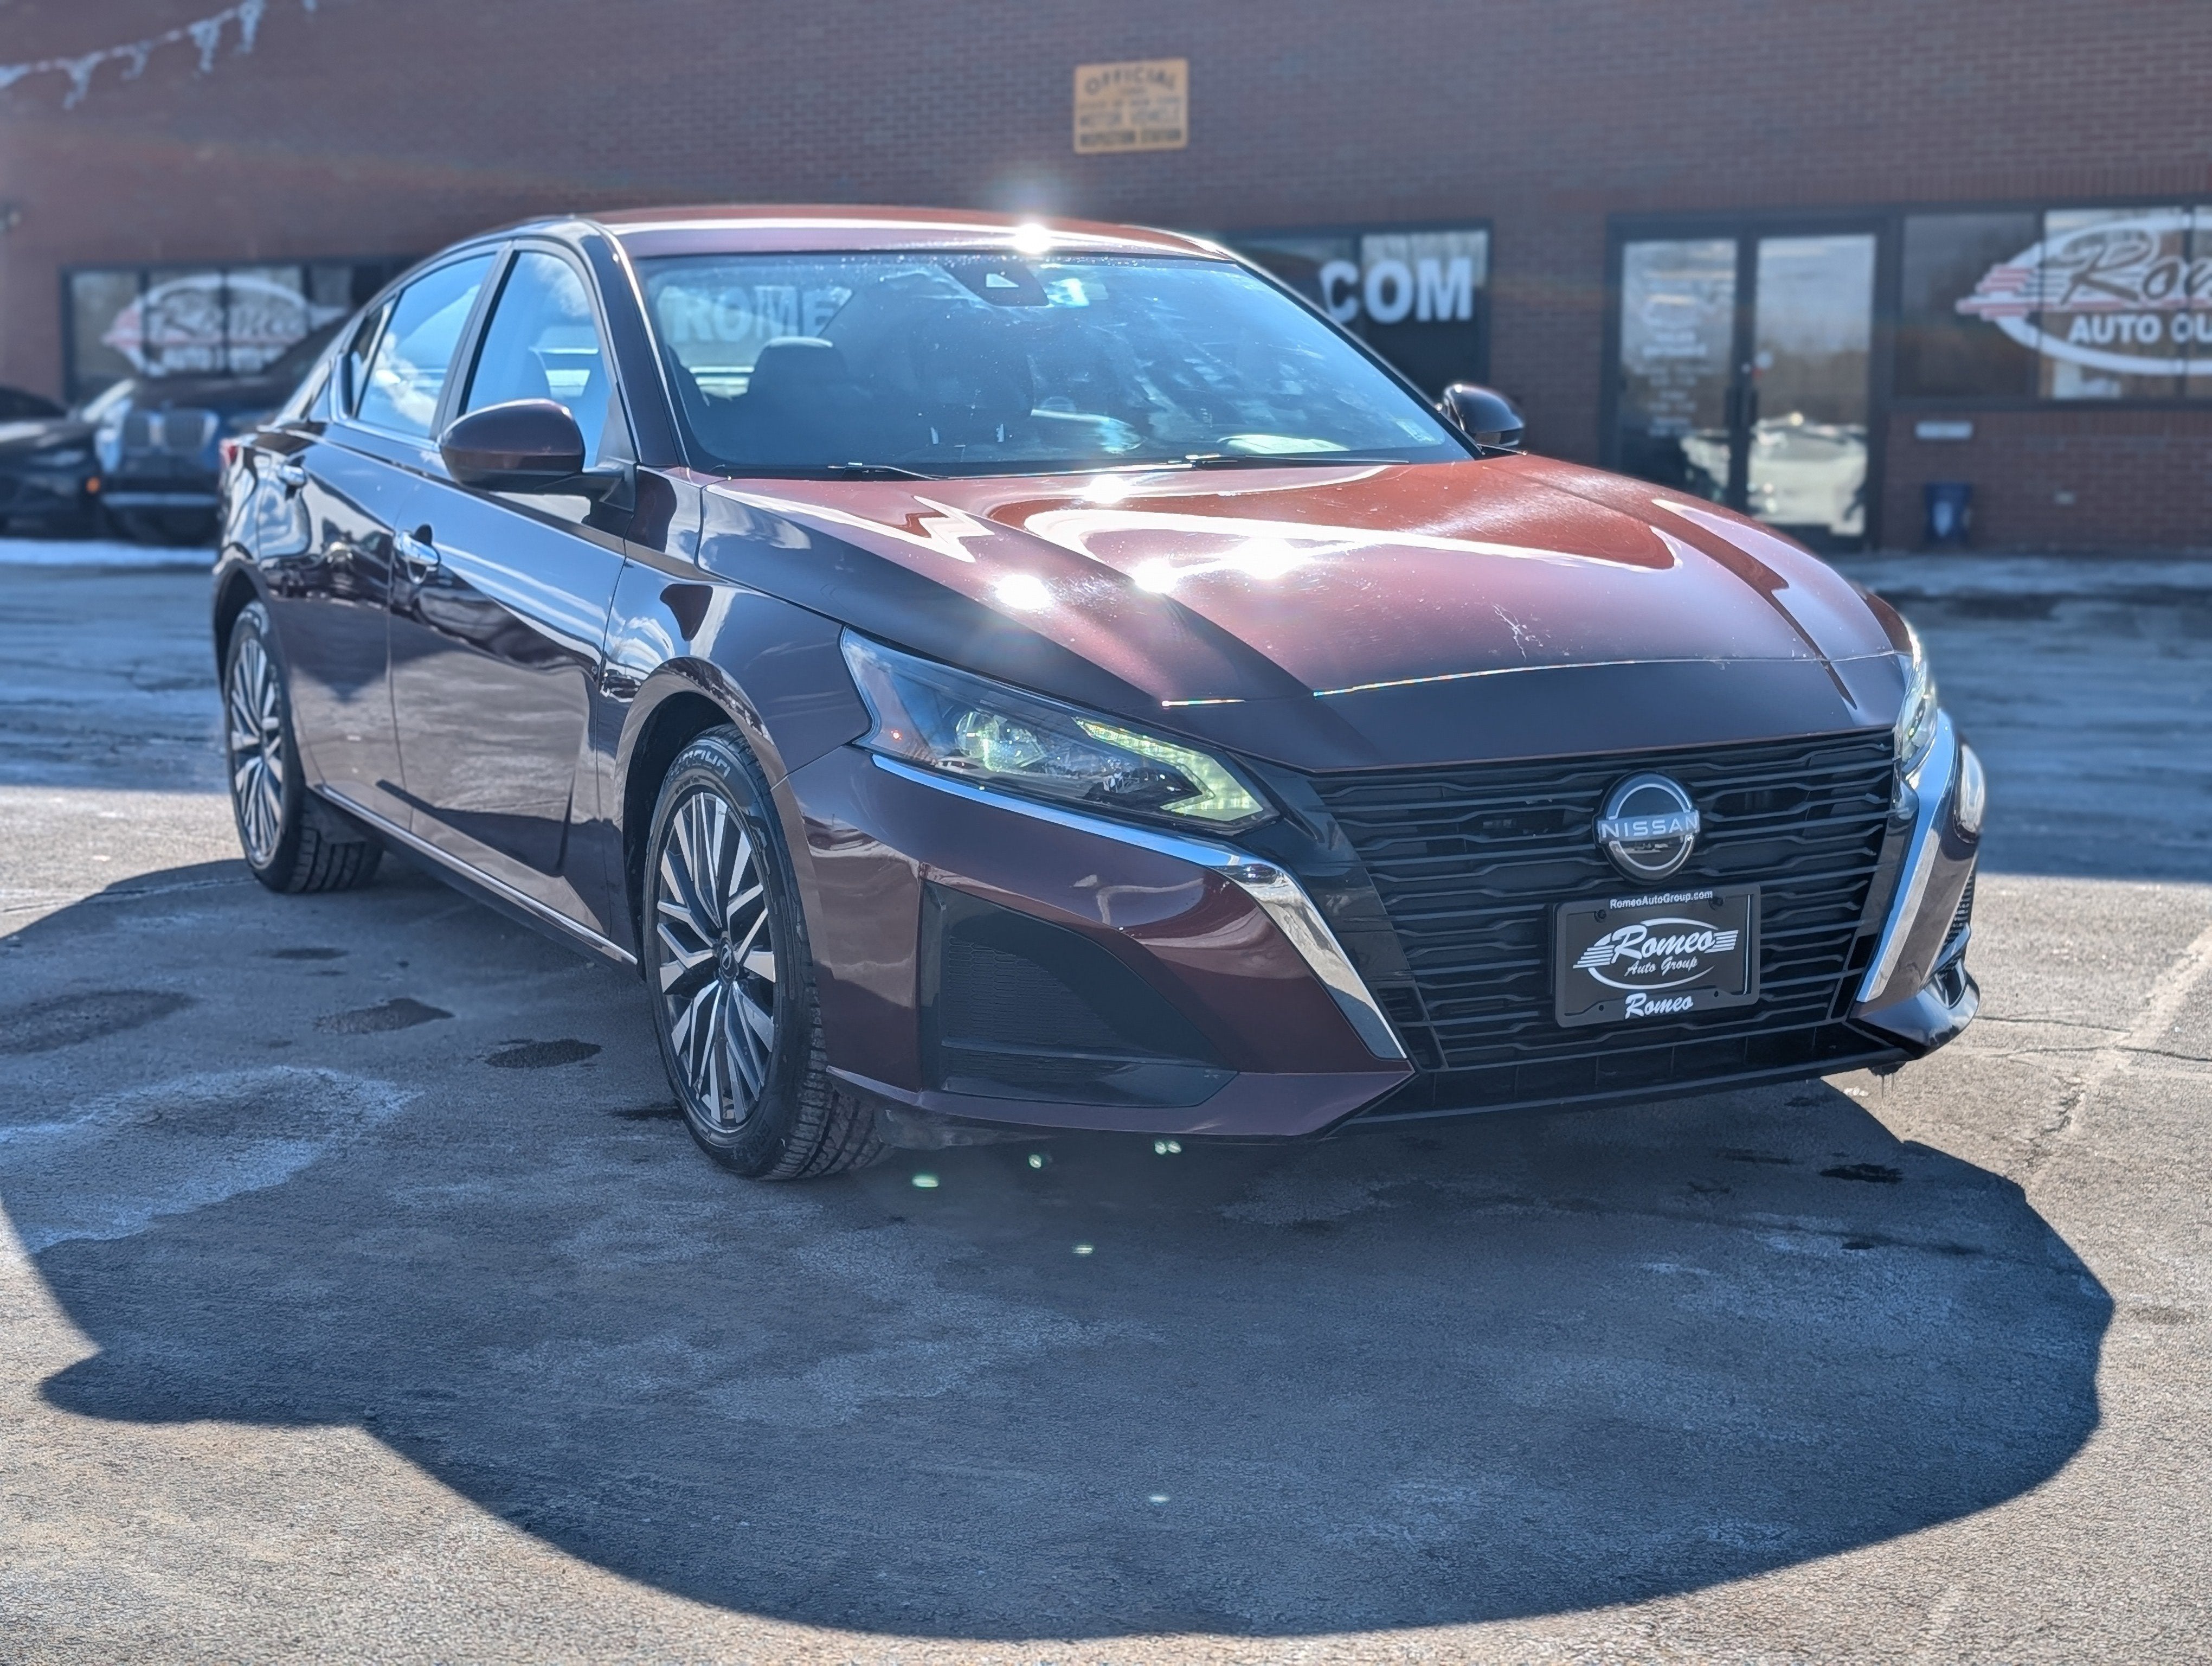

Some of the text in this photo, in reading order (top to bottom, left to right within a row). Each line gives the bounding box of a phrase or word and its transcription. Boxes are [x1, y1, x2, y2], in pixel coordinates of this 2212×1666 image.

[2068, 315, 2163, 344] AUTO
[1601, 815, 1698, 838] NISSAN
[1610, 890, 1713, 909] RomeoAutoGroup.com
[1611, 924, 1715, 964] Romeo
[1624, 956, 1698, 977] Auto Group
[1624, 992, 1694, 1020] Romeo
